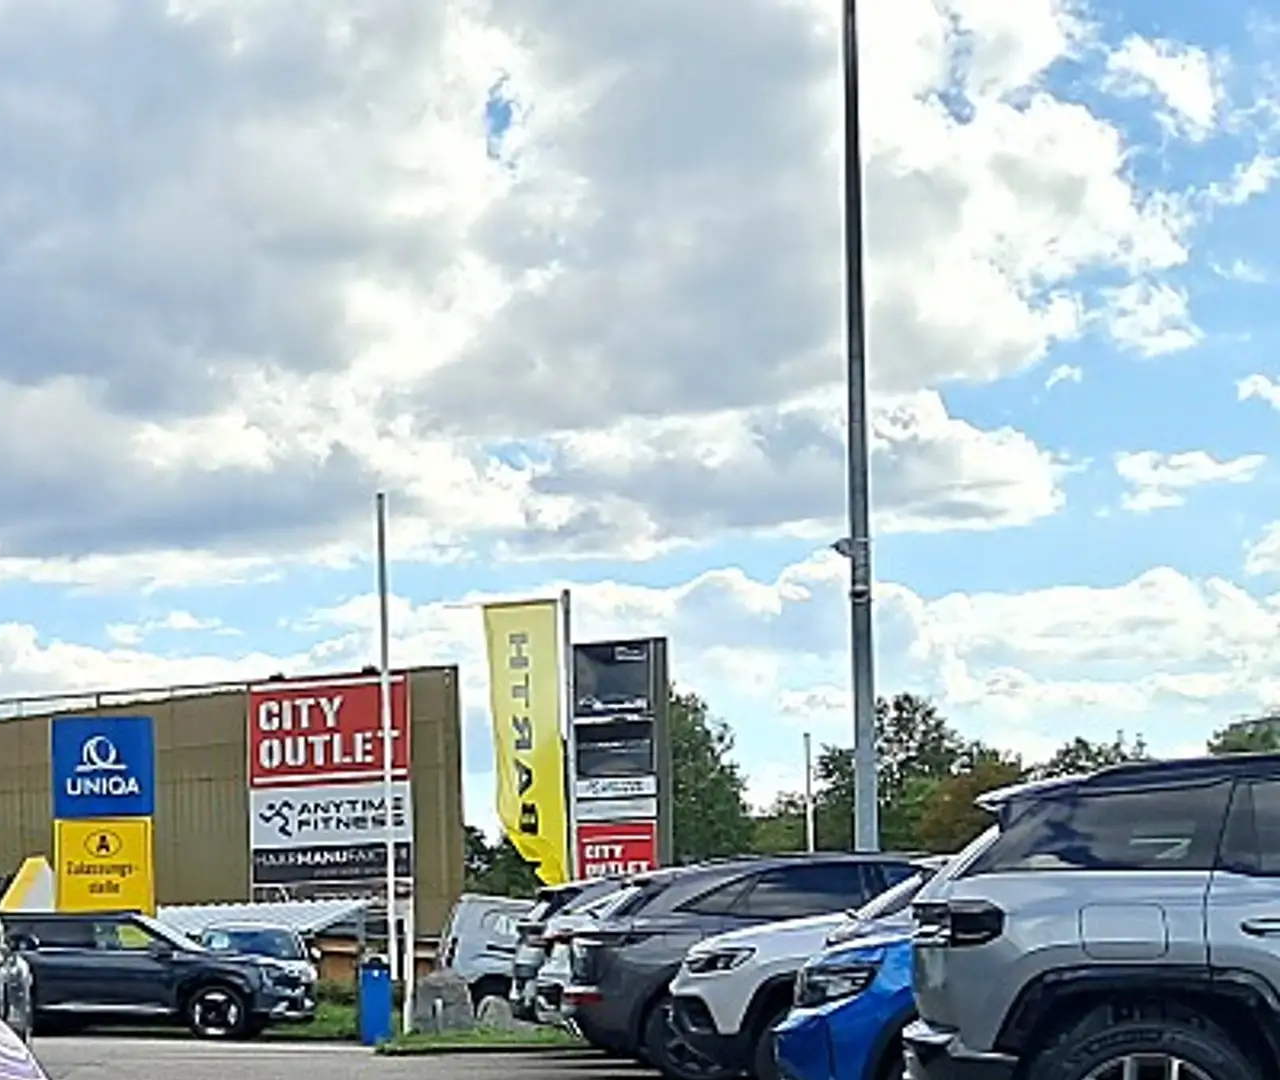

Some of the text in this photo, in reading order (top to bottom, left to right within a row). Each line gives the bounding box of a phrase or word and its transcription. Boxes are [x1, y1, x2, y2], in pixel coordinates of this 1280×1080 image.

[259, 695, 343, 731] CITY
[66, 775, 140, 796] UNIQA
[297, 796, 404, 817] ANYTIME
[297, 813, 405, 832] FITNESS
[96, 835, 110, 853] A
[584, 843, 624, 859] CITY
[255, 847, 408, 866] HAARMANUFAKTR
